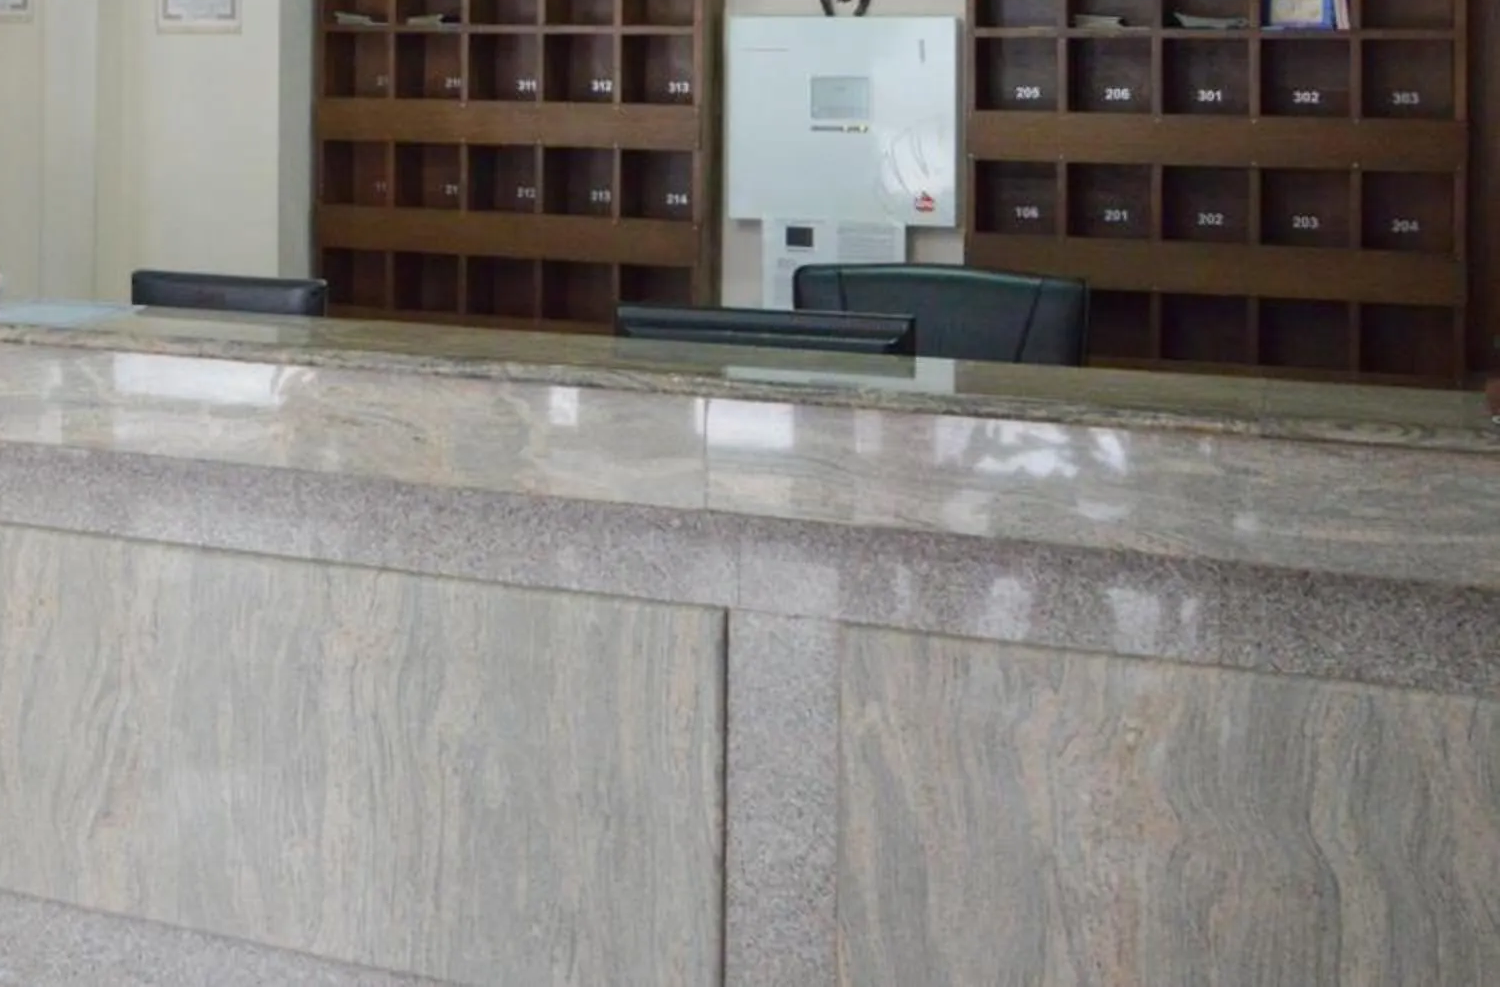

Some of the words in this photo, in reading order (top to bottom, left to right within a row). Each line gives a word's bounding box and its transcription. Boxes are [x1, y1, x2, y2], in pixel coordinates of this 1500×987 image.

[591, 79, 613, 93] 312
[1015, 85, 1041, 100] 205
[1104, 87, 1132, 101] 206
[1197, 89, 1223, 103] 301
[1292, 90, 1321, 105] 302
[1103, 208, 1129, 222] 201
[1292, 215, 1320, 230] 203
